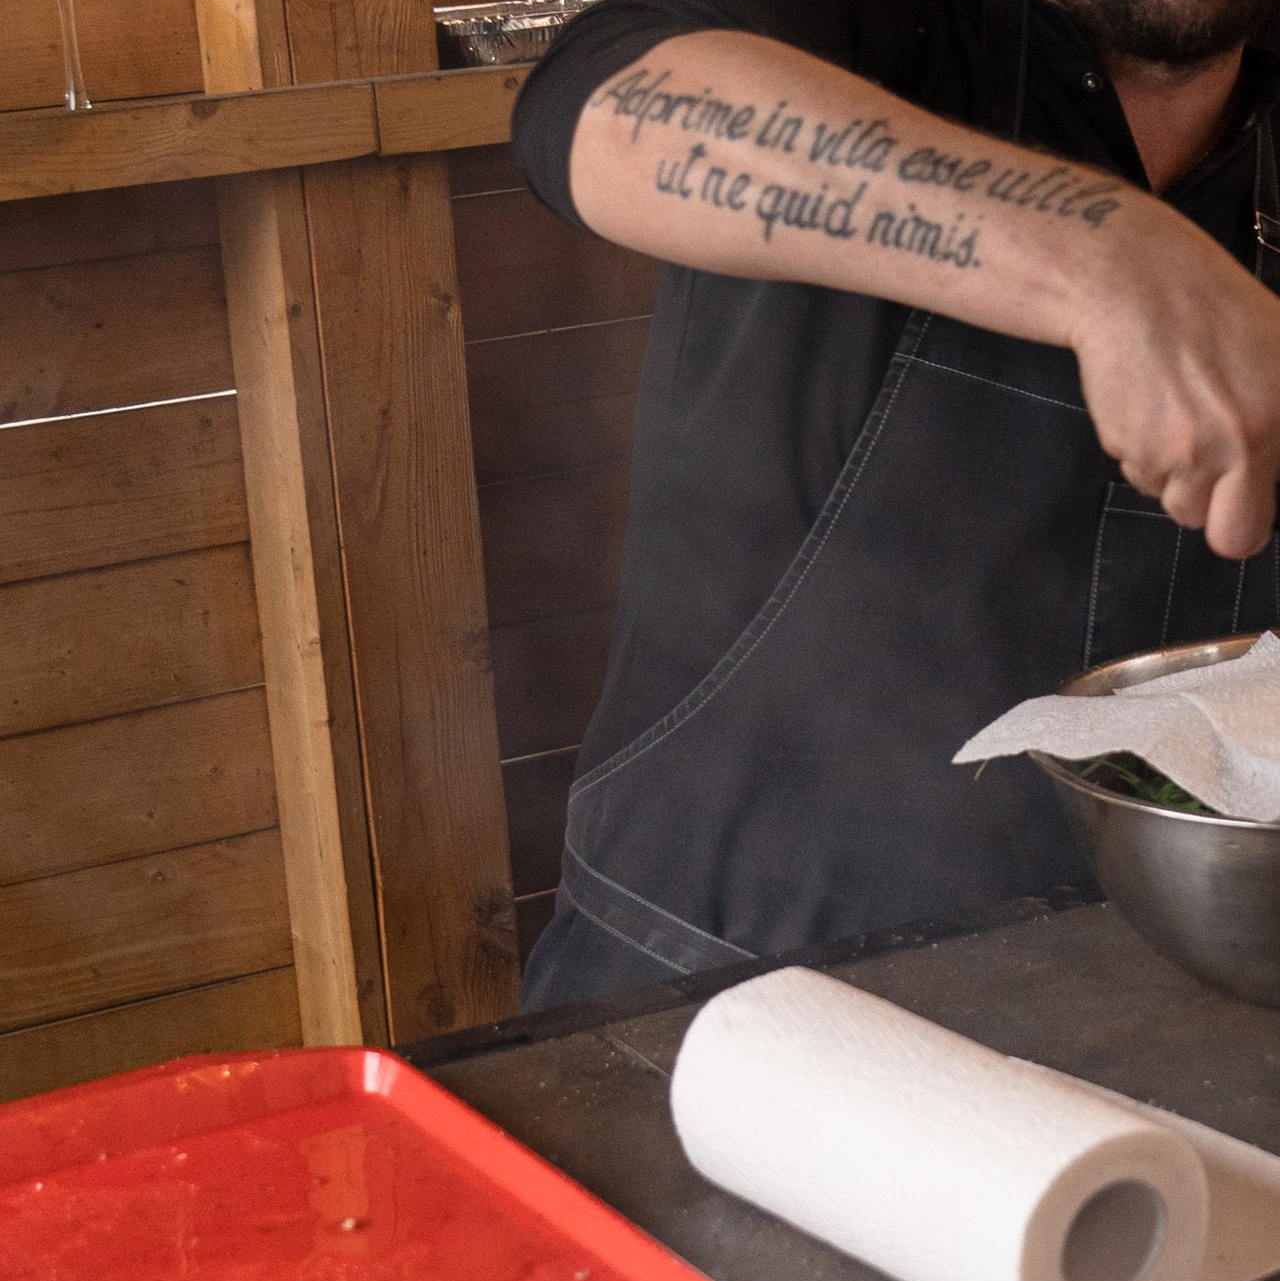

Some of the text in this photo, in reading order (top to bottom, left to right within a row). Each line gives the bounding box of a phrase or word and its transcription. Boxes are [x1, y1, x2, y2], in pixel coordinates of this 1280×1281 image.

[754, 99, 805, 154] in
[655, 144, 708, 199] ut
[701, 166, 752, 211] ne
[755, 182, 868, 244] quid
